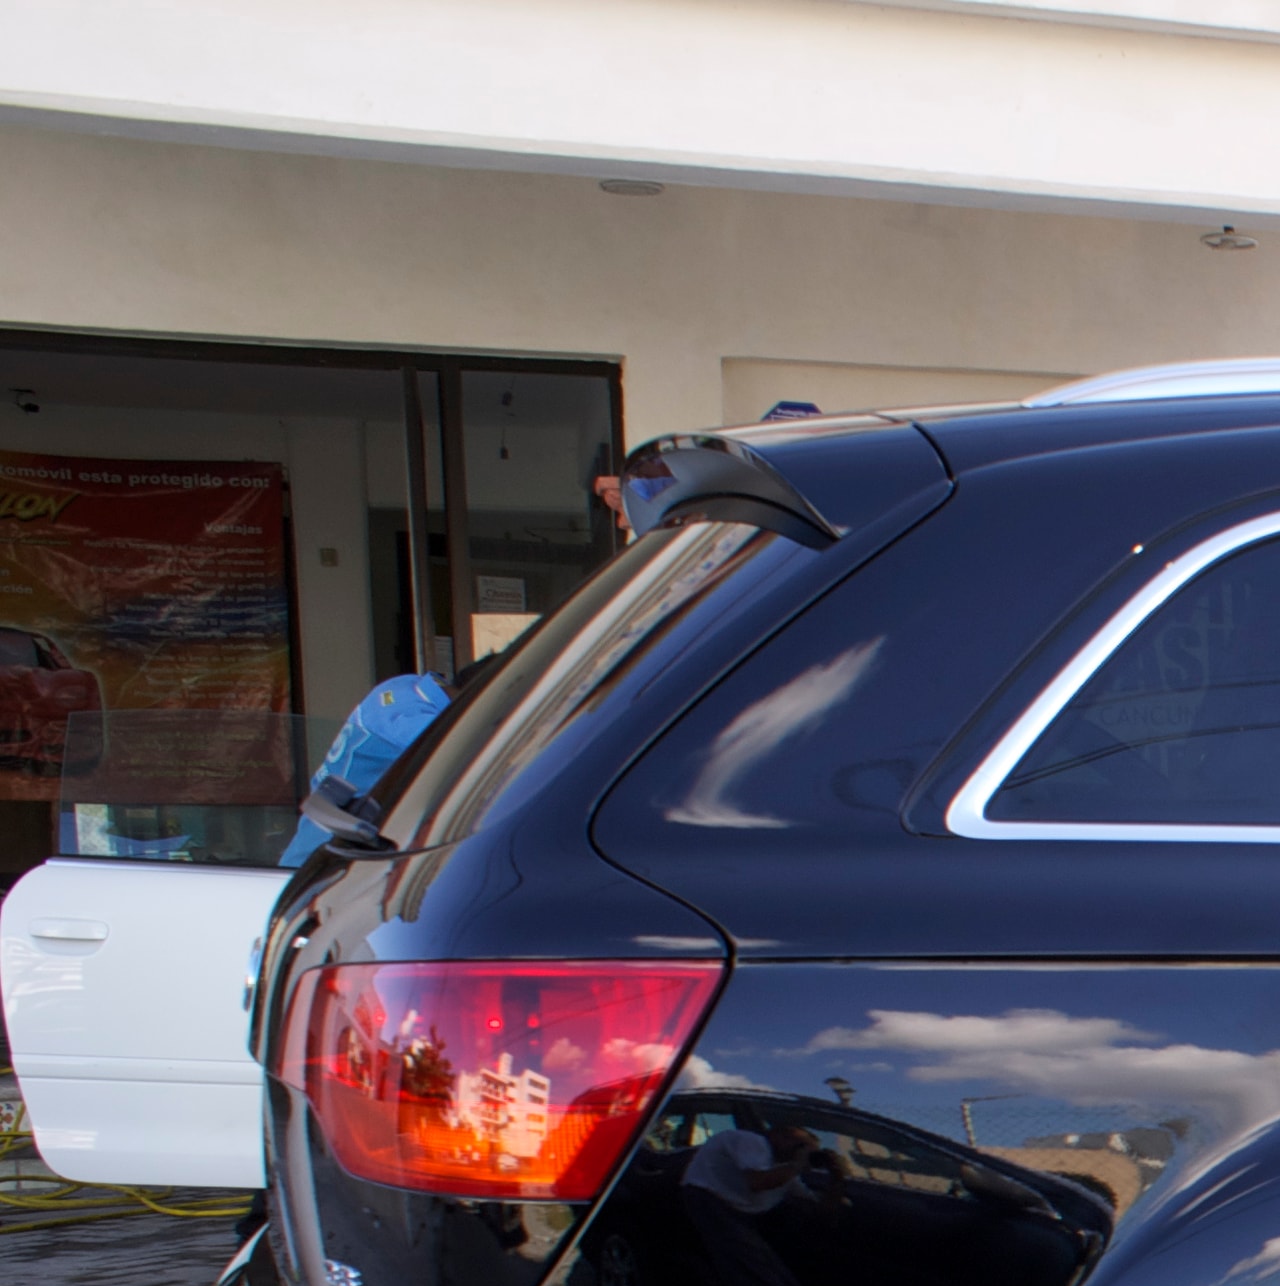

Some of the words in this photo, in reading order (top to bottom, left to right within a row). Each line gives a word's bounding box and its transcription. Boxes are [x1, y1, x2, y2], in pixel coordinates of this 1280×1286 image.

[79, 470, 122, 484] esta
[129, 473, 223, 488] protegido
[228, 476, 269, 489] con:
